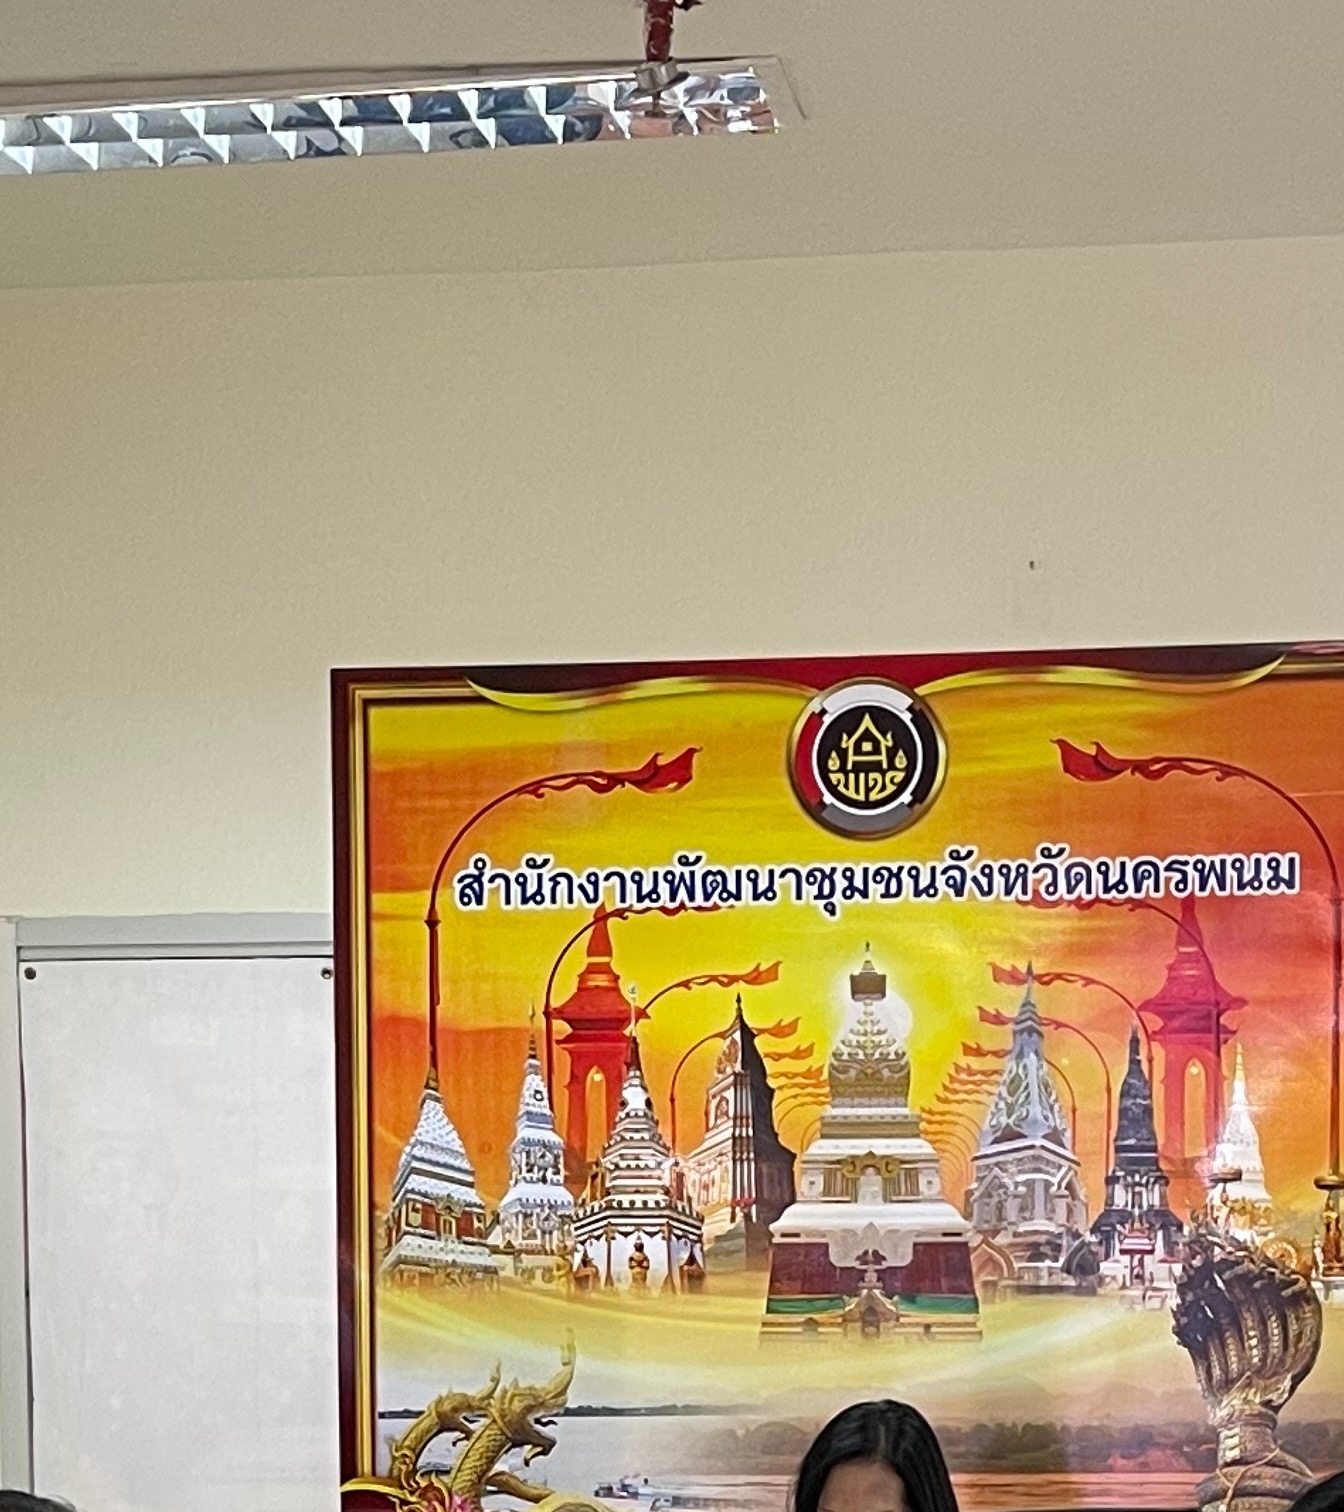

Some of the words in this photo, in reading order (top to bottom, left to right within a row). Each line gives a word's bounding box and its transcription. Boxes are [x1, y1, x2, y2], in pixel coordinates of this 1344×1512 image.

[456, 846, 1297, 916] สำนักงานพัฒนาชุมชนจังหวัดนครพนม
